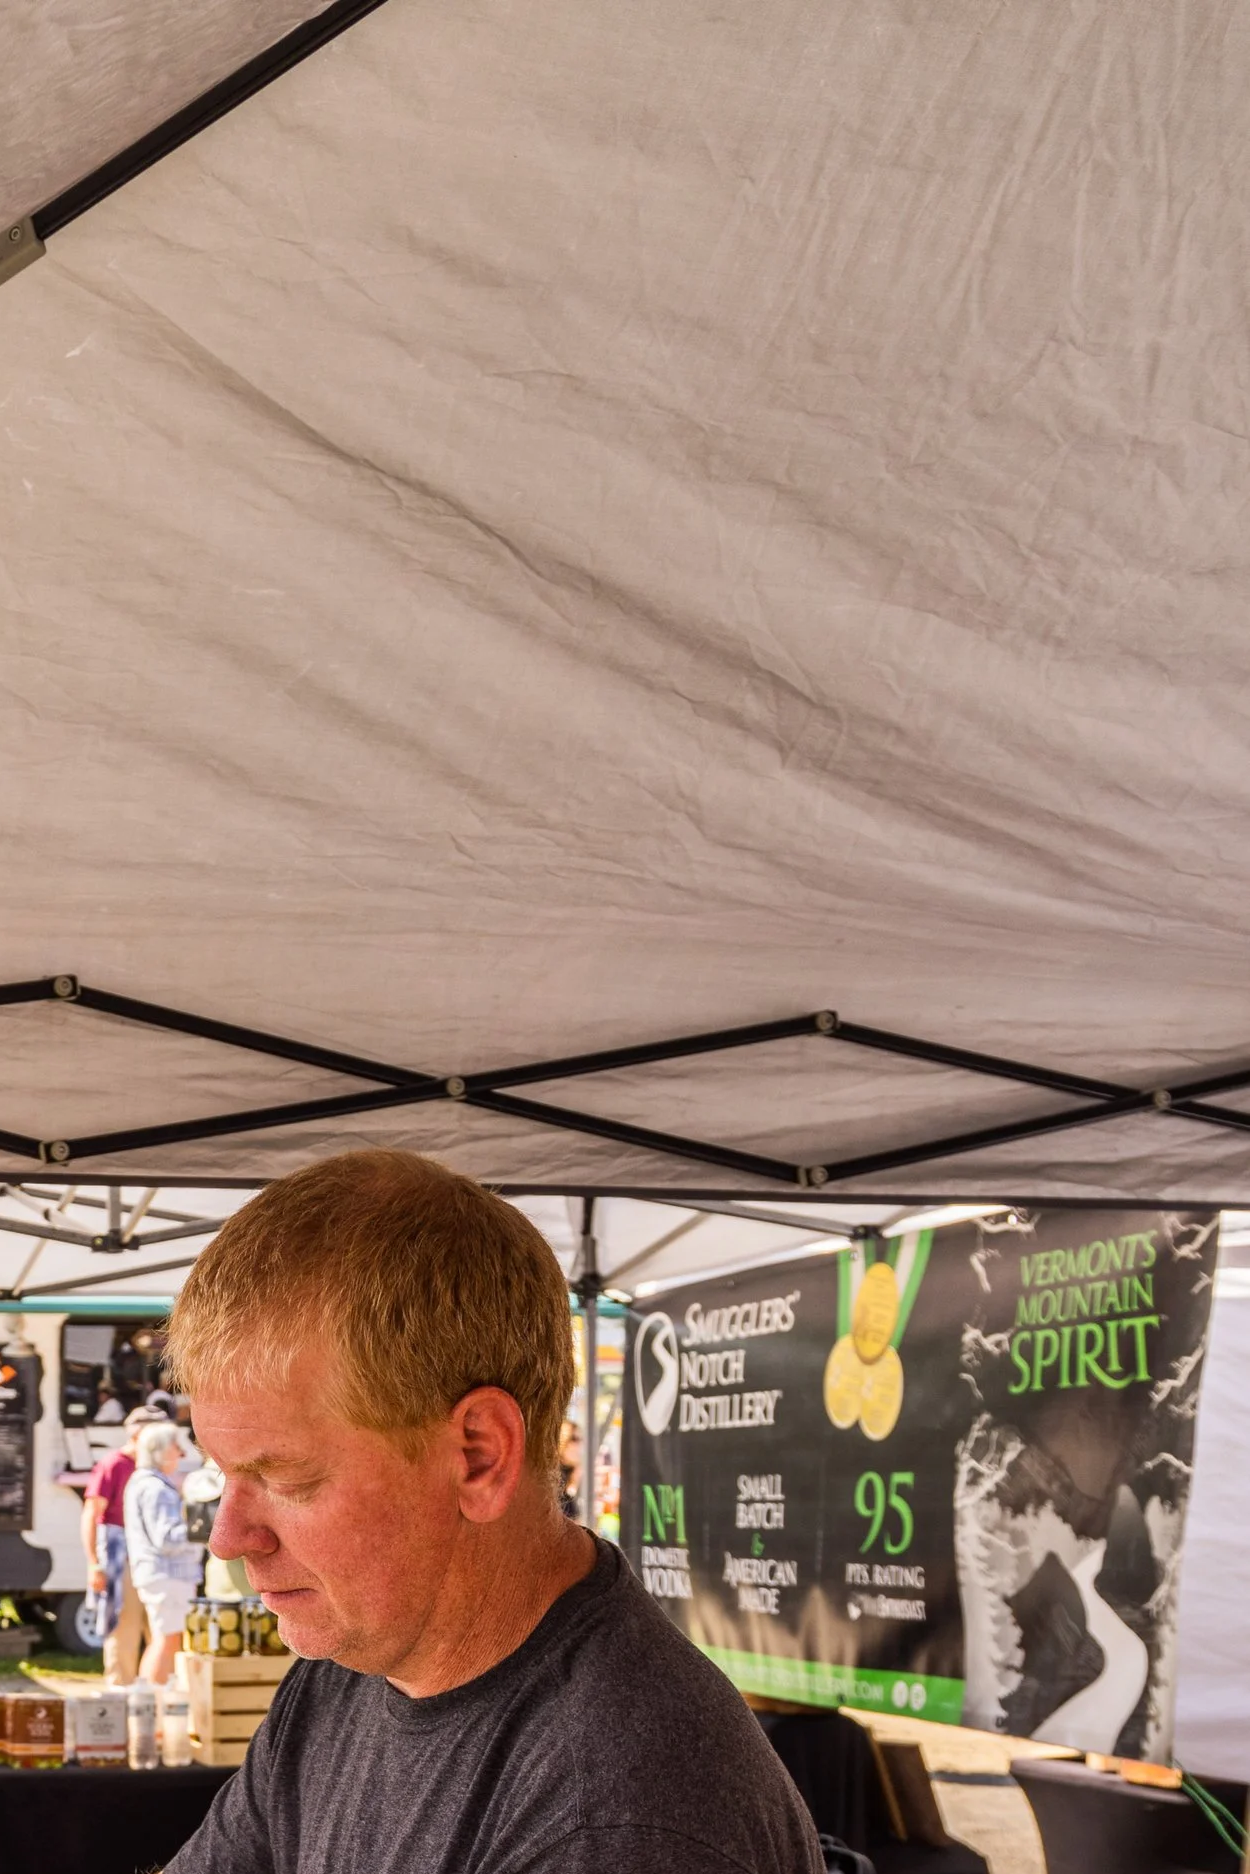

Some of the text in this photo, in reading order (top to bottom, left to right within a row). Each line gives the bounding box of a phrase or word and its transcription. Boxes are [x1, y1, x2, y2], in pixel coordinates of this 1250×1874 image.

[1020, 1229, 1158, 1288] VERMONT'S
[1015, 1273, 1154, 1328] MOUNTAIN
[680, 1349, 746, 1389] NOTCH
[1007, 1315, 1161, 1395] SPIRIT
[679, 1389, 779, 1432] DISTILLERY
[736, 1474, 785, 1501] SMALL
[735, 1502, 785, 1530] BATCH
[854, 1470, 915, 1556] 95
[751, 1532, 765, 1557] &
[642, 1568, 694, 1600] VODKA
[722, 1551, 798, 1589] AMERICAN
[872, 1564, 926, 1589] RATING
[737, 1586, 781, 1616] MADE
